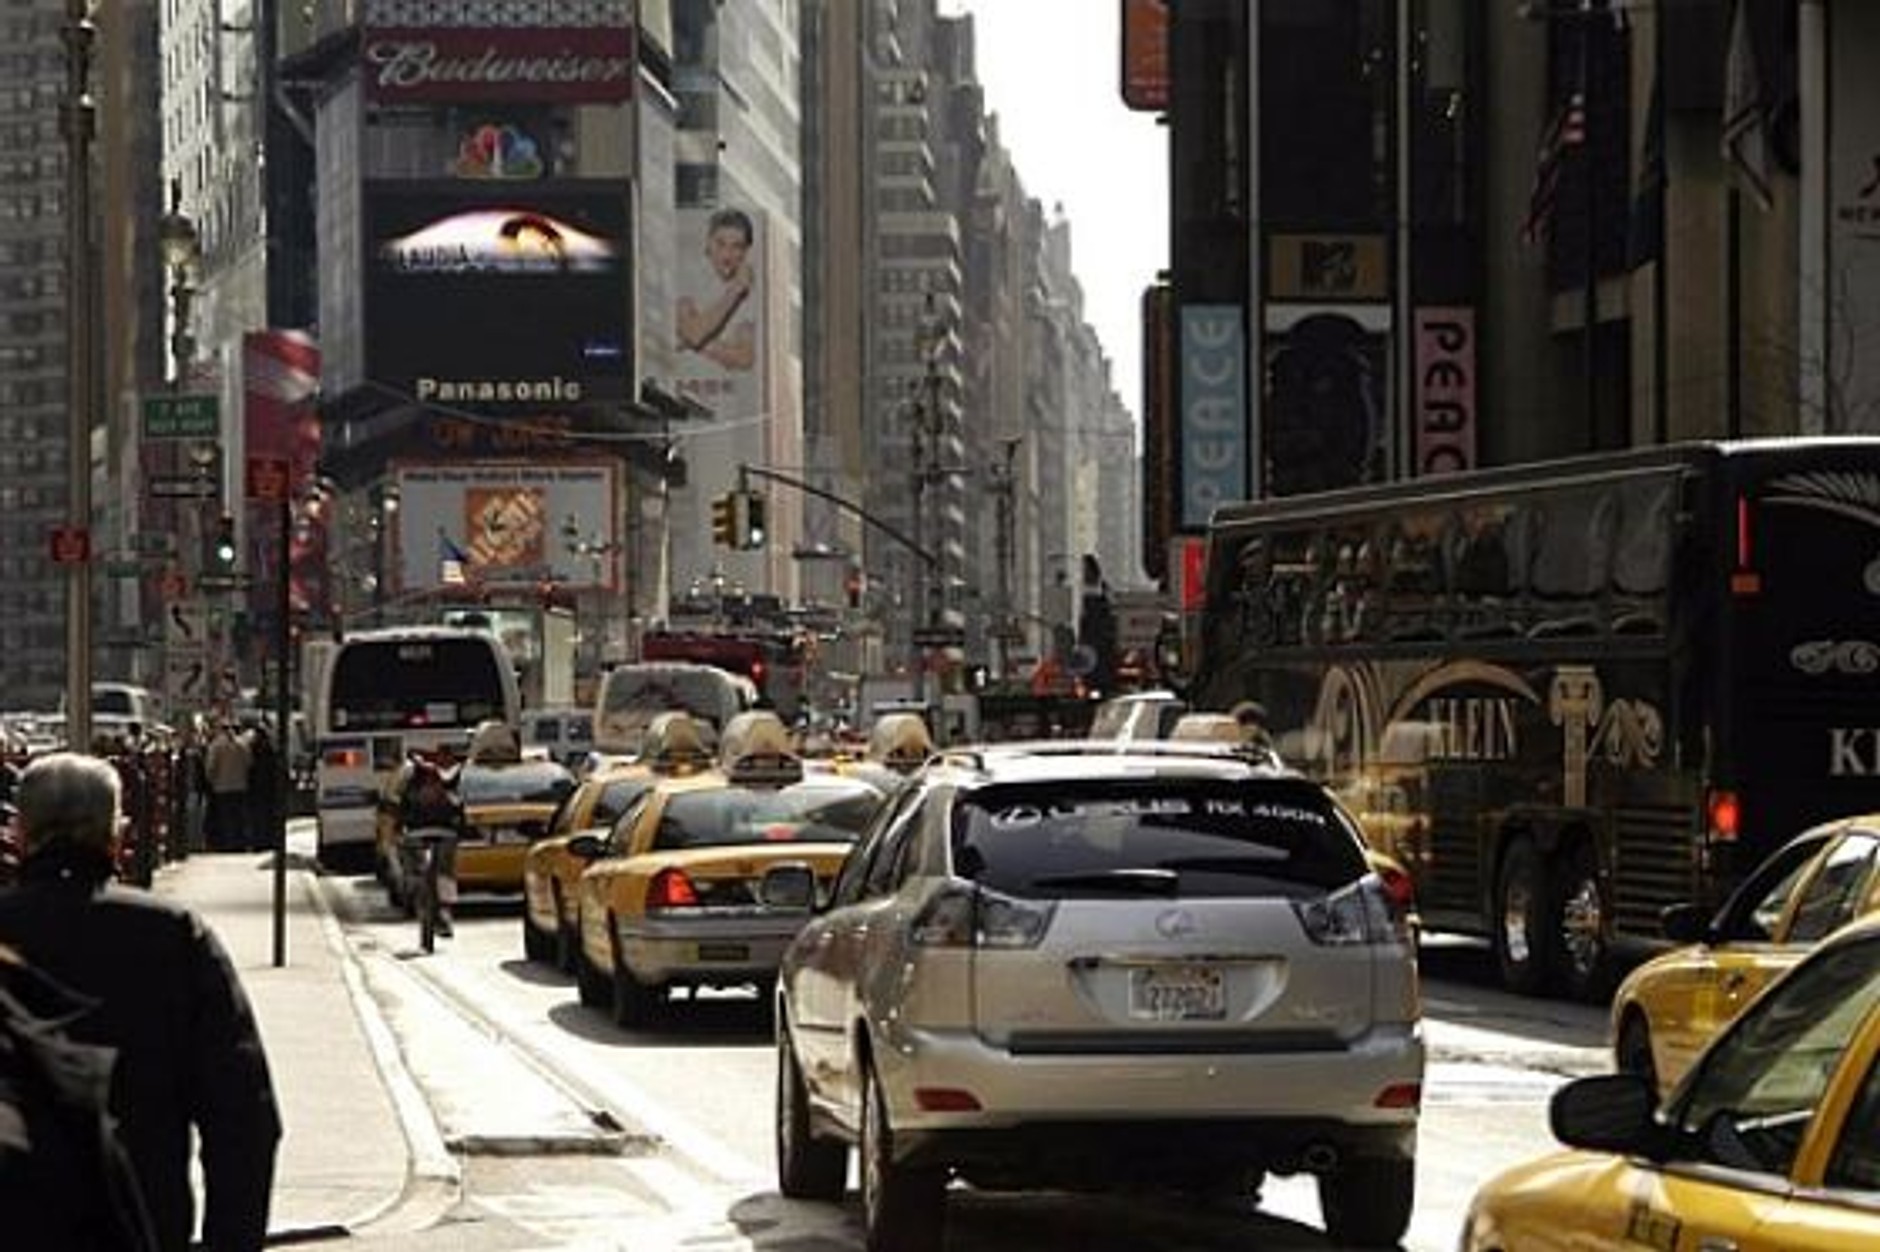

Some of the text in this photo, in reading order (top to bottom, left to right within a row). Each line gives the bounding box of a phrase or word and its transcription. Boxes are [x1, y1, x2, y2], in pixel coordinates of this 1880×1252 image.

[369, 44, 627, 87] Budweiser
[416, 376, 583, 401] Panasonic
[1424, 321, 1468, 474] PEAC
[1429, 698, 1519, 760] KLEIN
